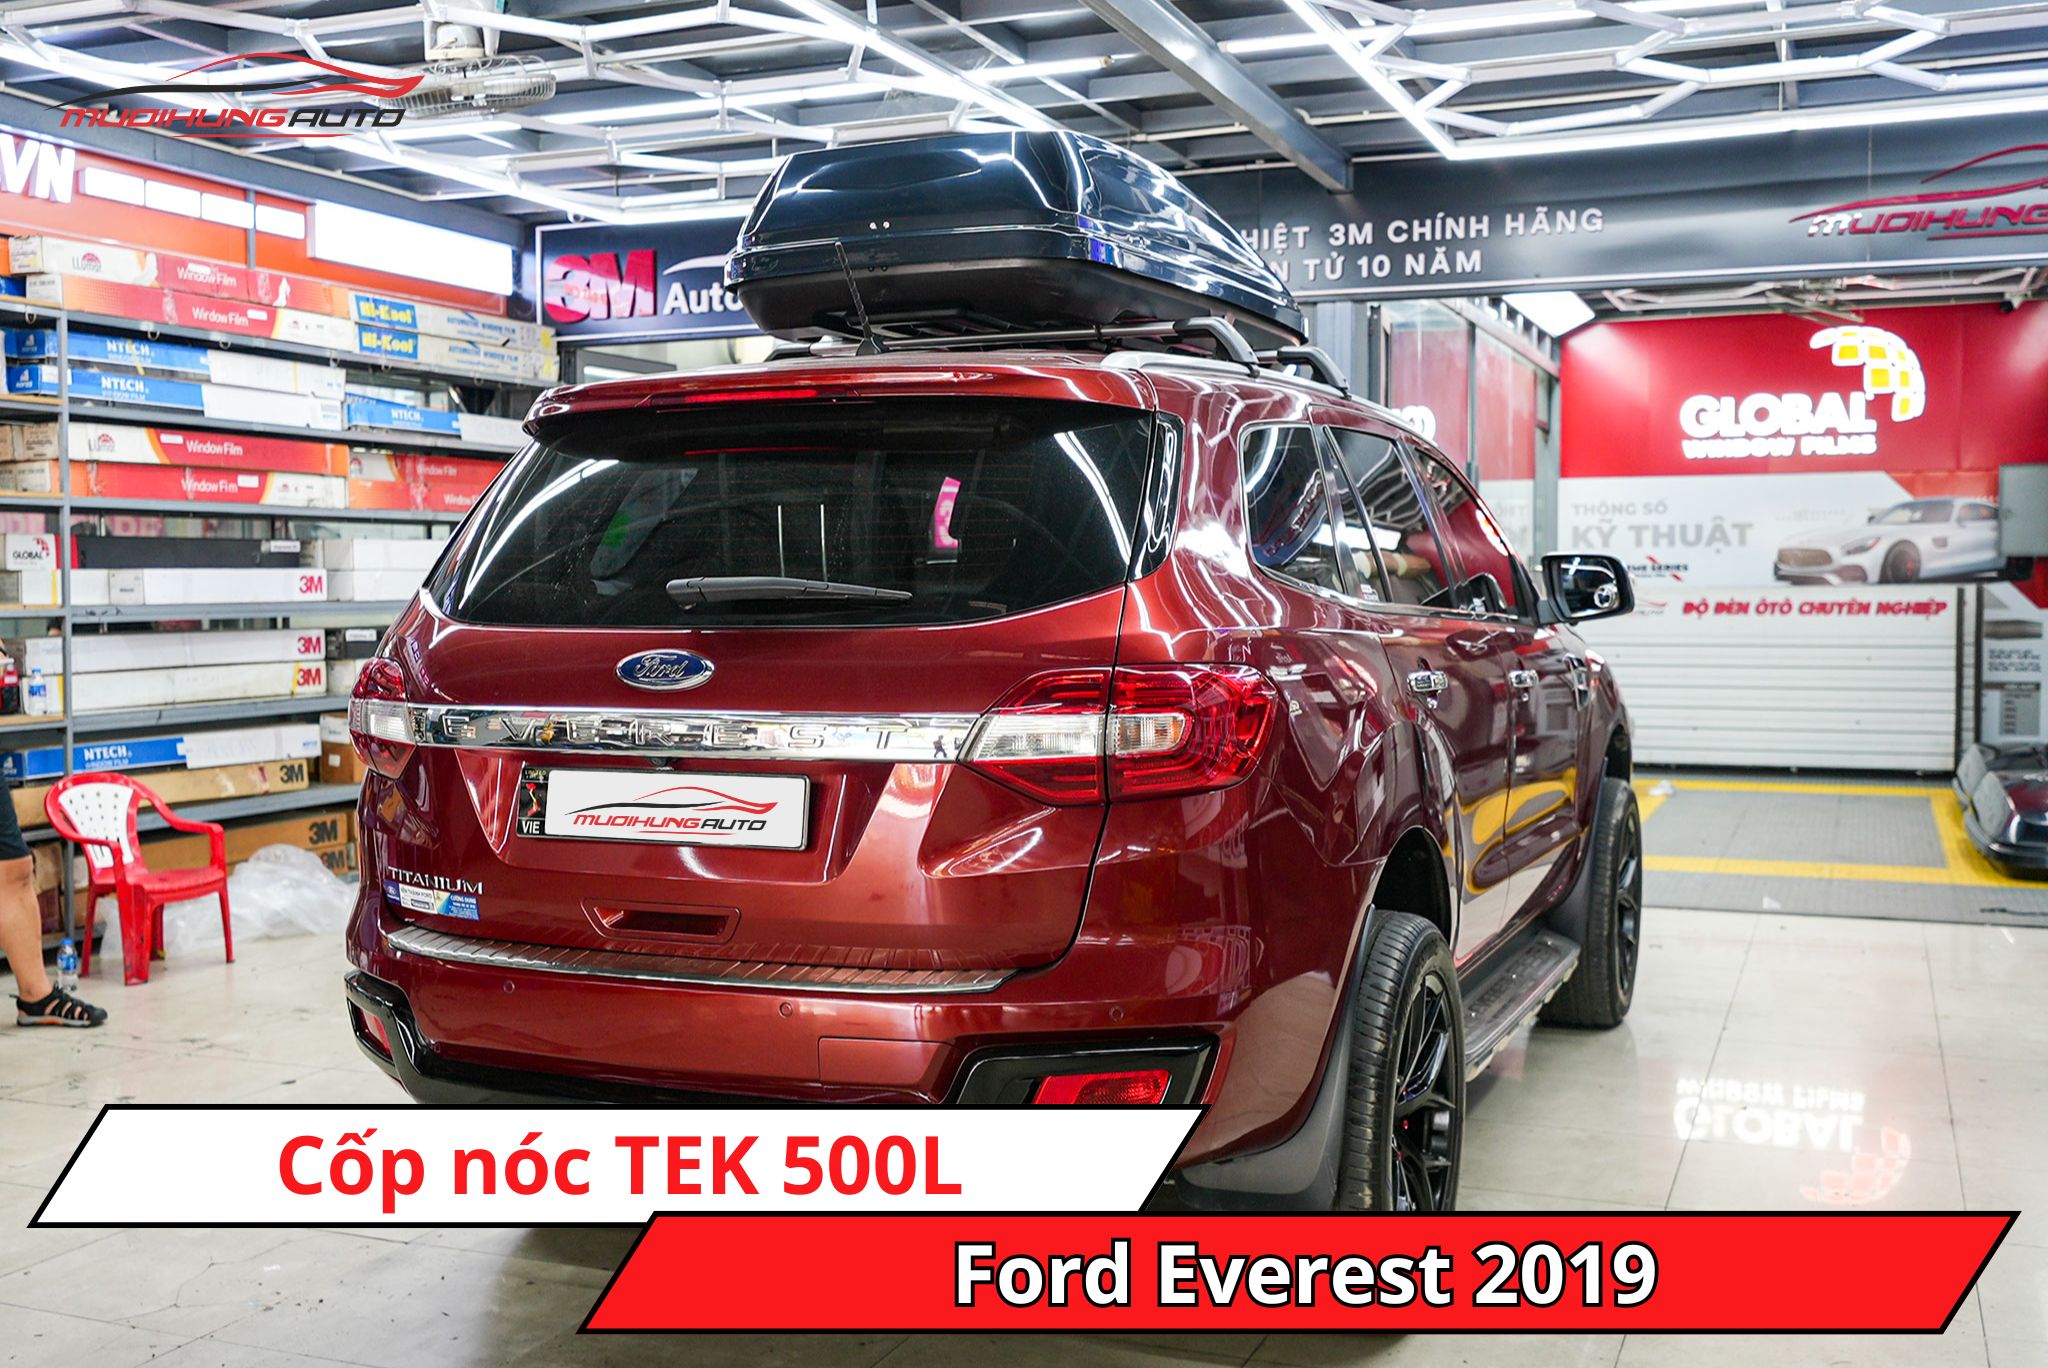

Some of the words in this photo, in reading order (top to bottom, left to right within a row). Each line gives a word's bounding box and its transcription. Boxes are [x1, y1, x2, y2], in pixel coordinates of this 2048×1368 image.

[1328, 222, 1373, 246] 3M
[1386, 212, 1490, 244] CHÍNH
[1504, 206, 1604, 236] HÃNG
[1356, 254, 1391, 279] 10
[1405, 246, 1482, 277] NĂM
[216, 274, 238, 288] Film
[545, 249, 655, 323] 3M
[228, 312, 249, 327] Film
[106, 339, 151, 356] NTECH
[101, 376, 145, 391] NTECH
[1679, 391, 1877, 438] GLOBAL
[186, 440, 223, 455] Window
[223, 442, 244, 456] Film
[1571, 499, 1637, 516] THÔNG
[1571, 518, 1617, 549] KỸ
[1628, 516, 1754, 554] THUẬT
[12, 551, 43, 560] GLOBAL
[299, 575, 323, 594] 3M
[297, 636, 321, 655] 3M
[633, 654, 689, 678] Ford
[296, 668, 321, 687] 3M
[441, 713, 910, 750] EVEREST
[84, 745, 128, 761] NTECH
[279, 763, 305, 784] 3M
[308, 818, 338, 845] 3M
[521, 820, 541, 835] VIE
[321, 850, 345, 870] 3M
[388, 866, 483, 895] TITANIUM
